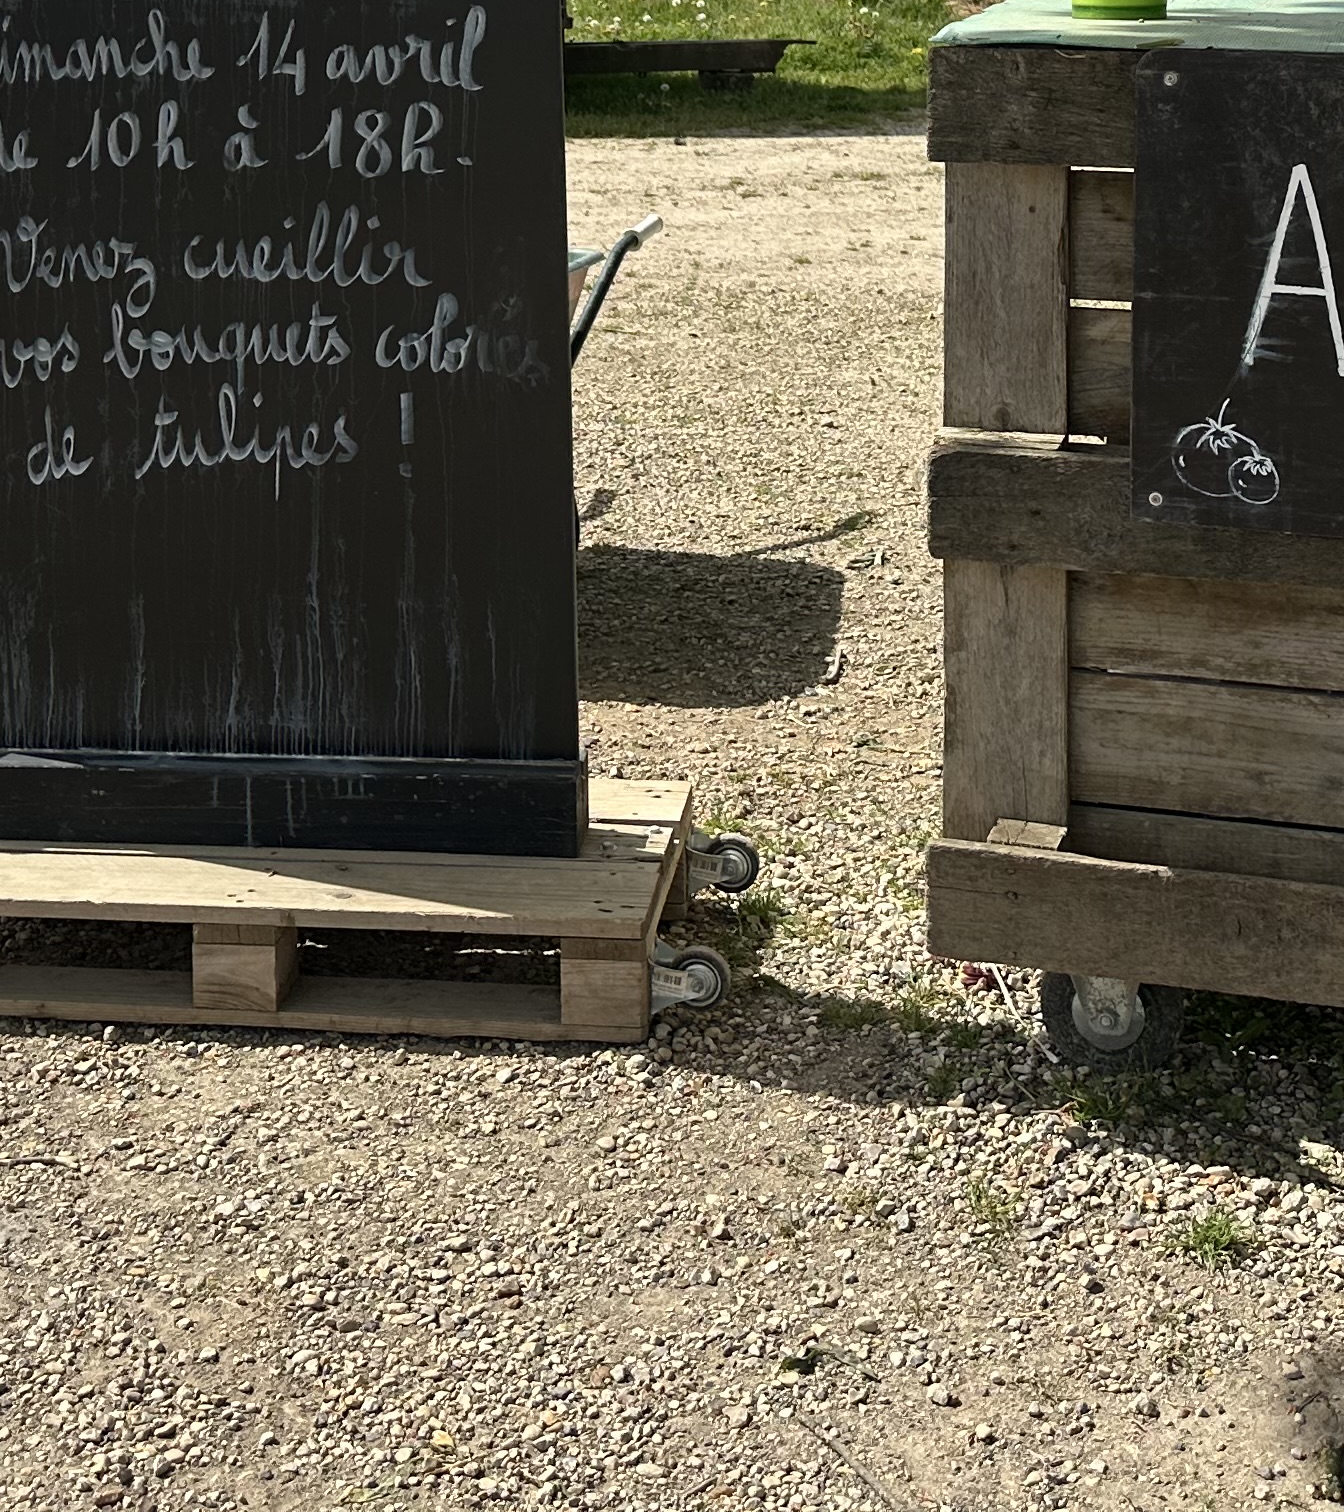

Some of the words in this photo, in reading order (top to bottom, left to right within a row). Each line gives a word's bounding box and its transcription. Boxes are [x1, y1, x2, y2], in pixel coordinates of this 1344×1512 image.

[236, 11, 306, 95] 14
[326, 4, 487, 92] avril
[224, 103, 269, 169] à
[184, 200, 433, 288] cueillir
[103, 301, 352, 393] bouquets
[27, 405, 92, 485] de
[135, 382, 358, 501] tulipes
[399, 392, 415, 478] !
